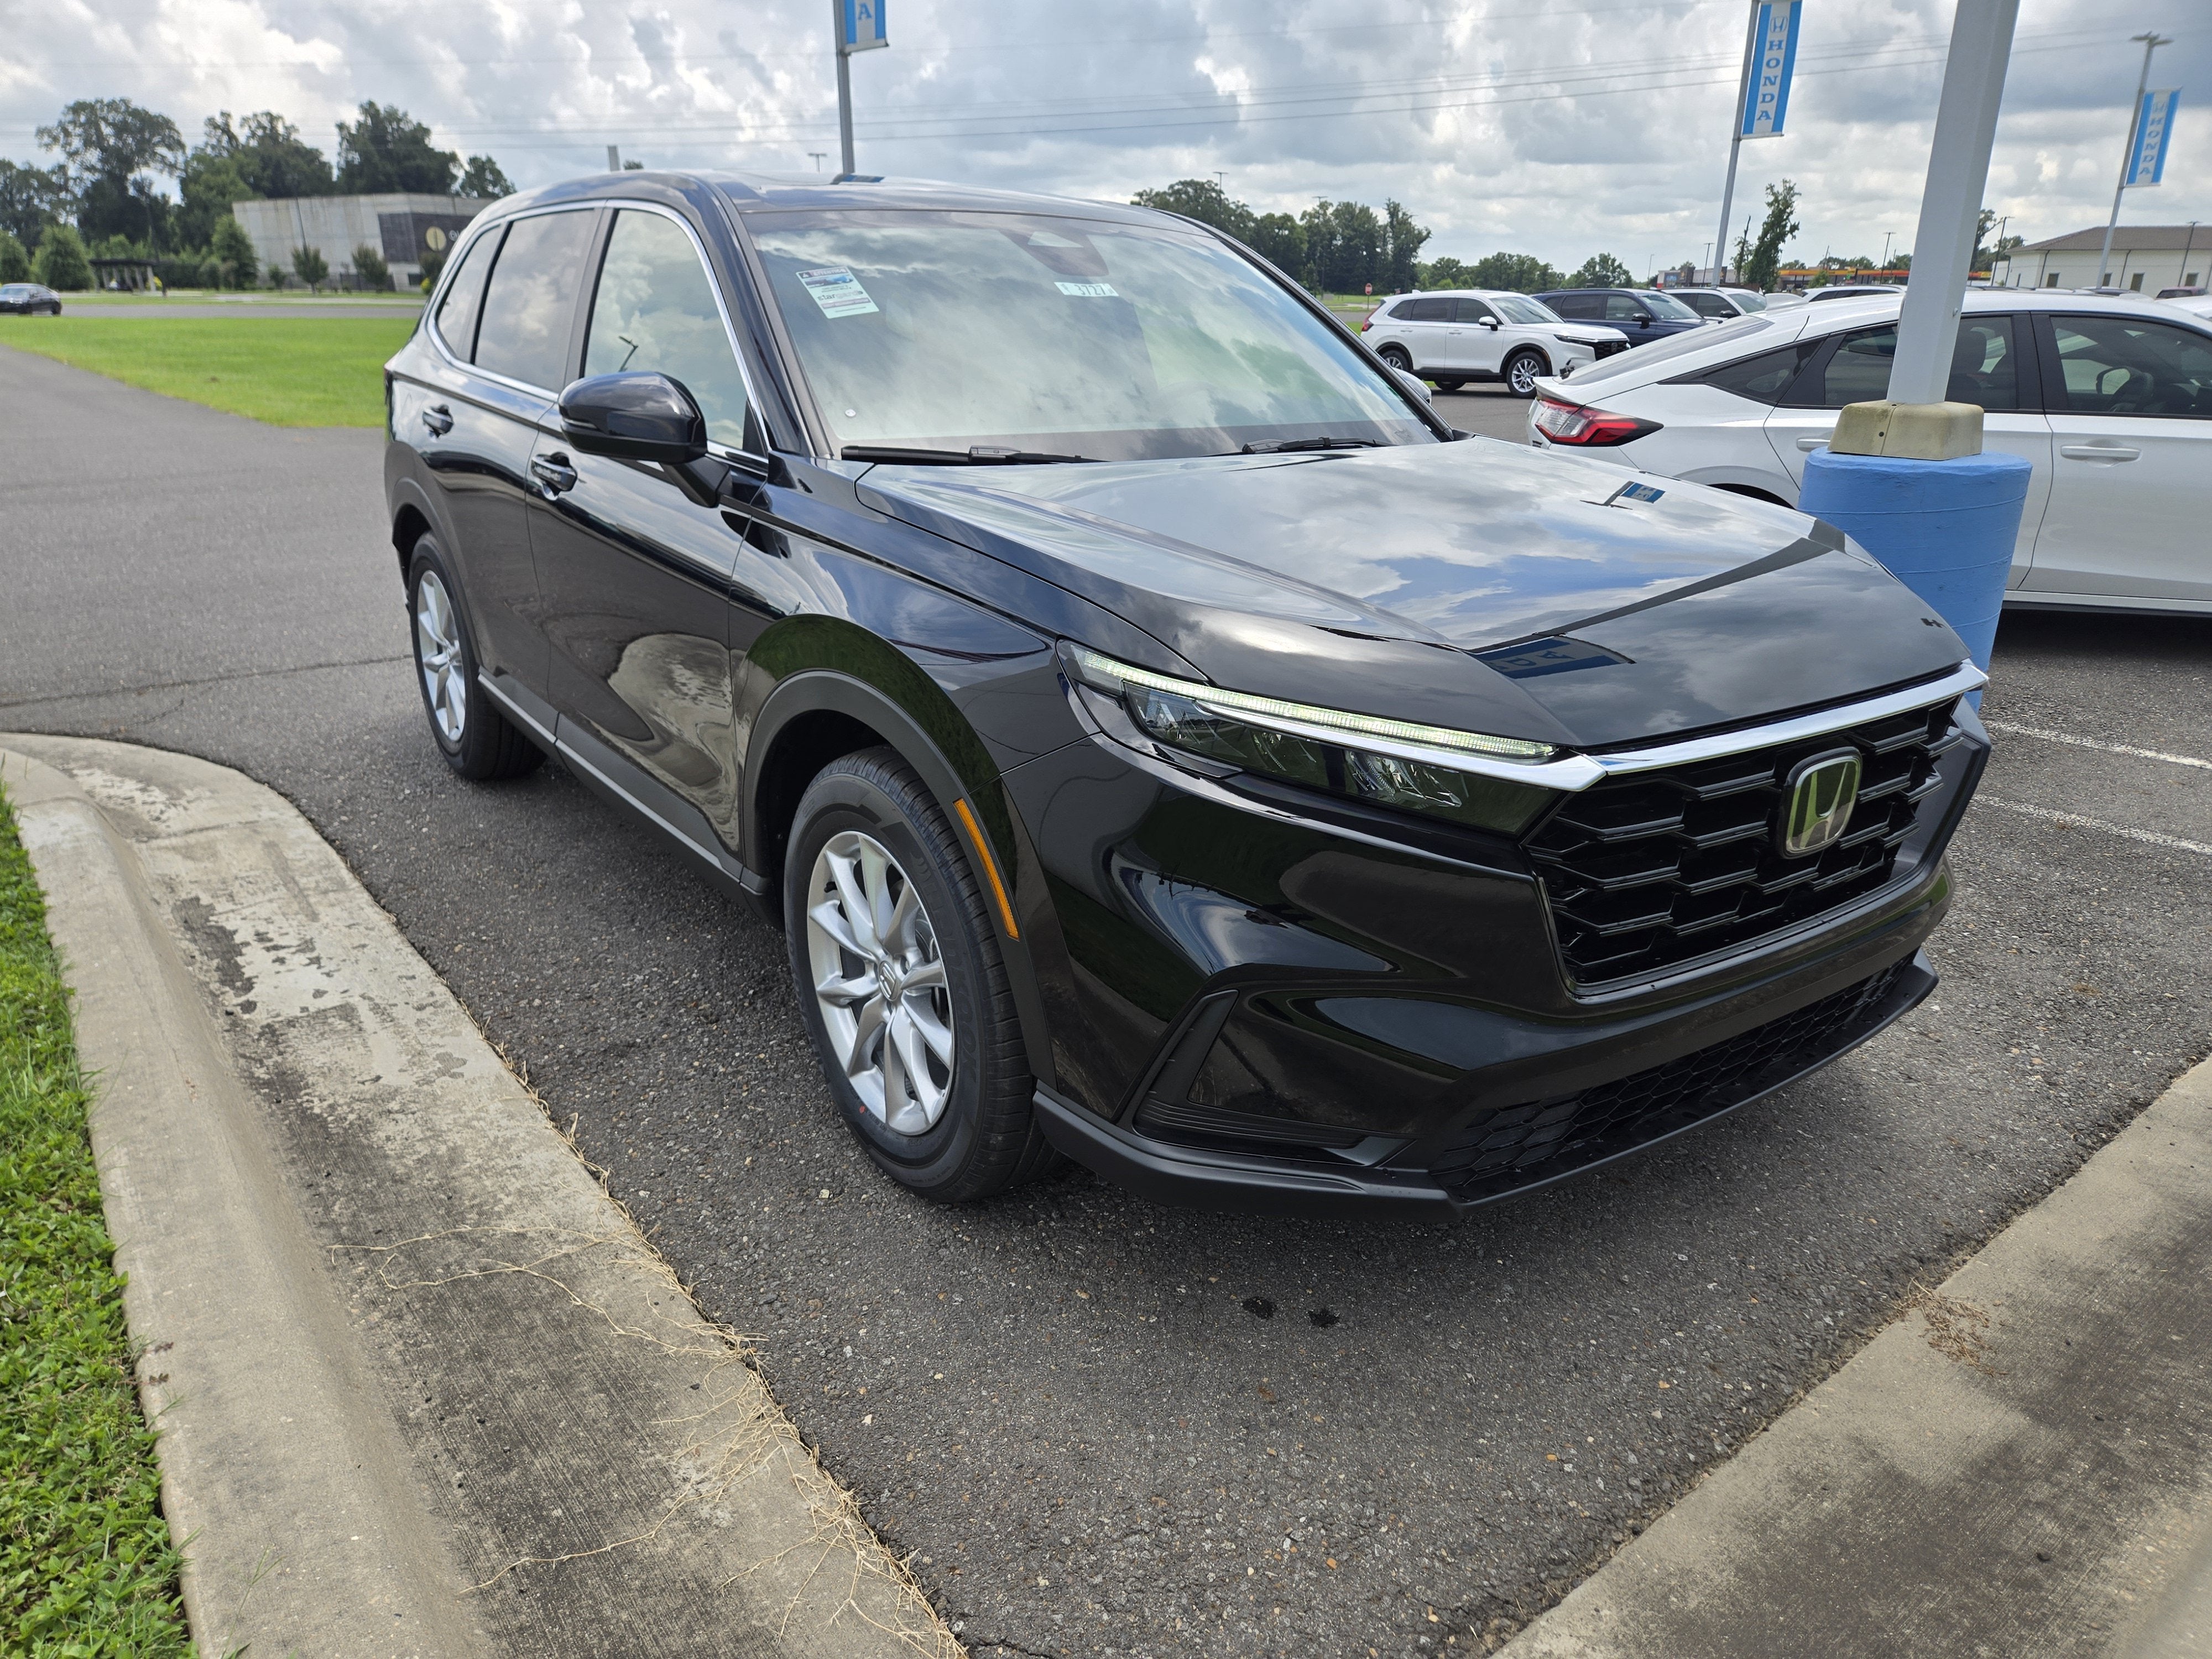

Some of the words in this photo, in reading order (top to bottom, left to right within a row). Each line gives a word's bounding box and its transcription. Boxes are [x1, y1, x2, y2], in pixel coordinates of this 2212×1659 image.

[1757, 40, 1784, 121] HONDA
[2138, 117, 2163, 175] HONDA
[1073, 284, 1106, 295] 3727
